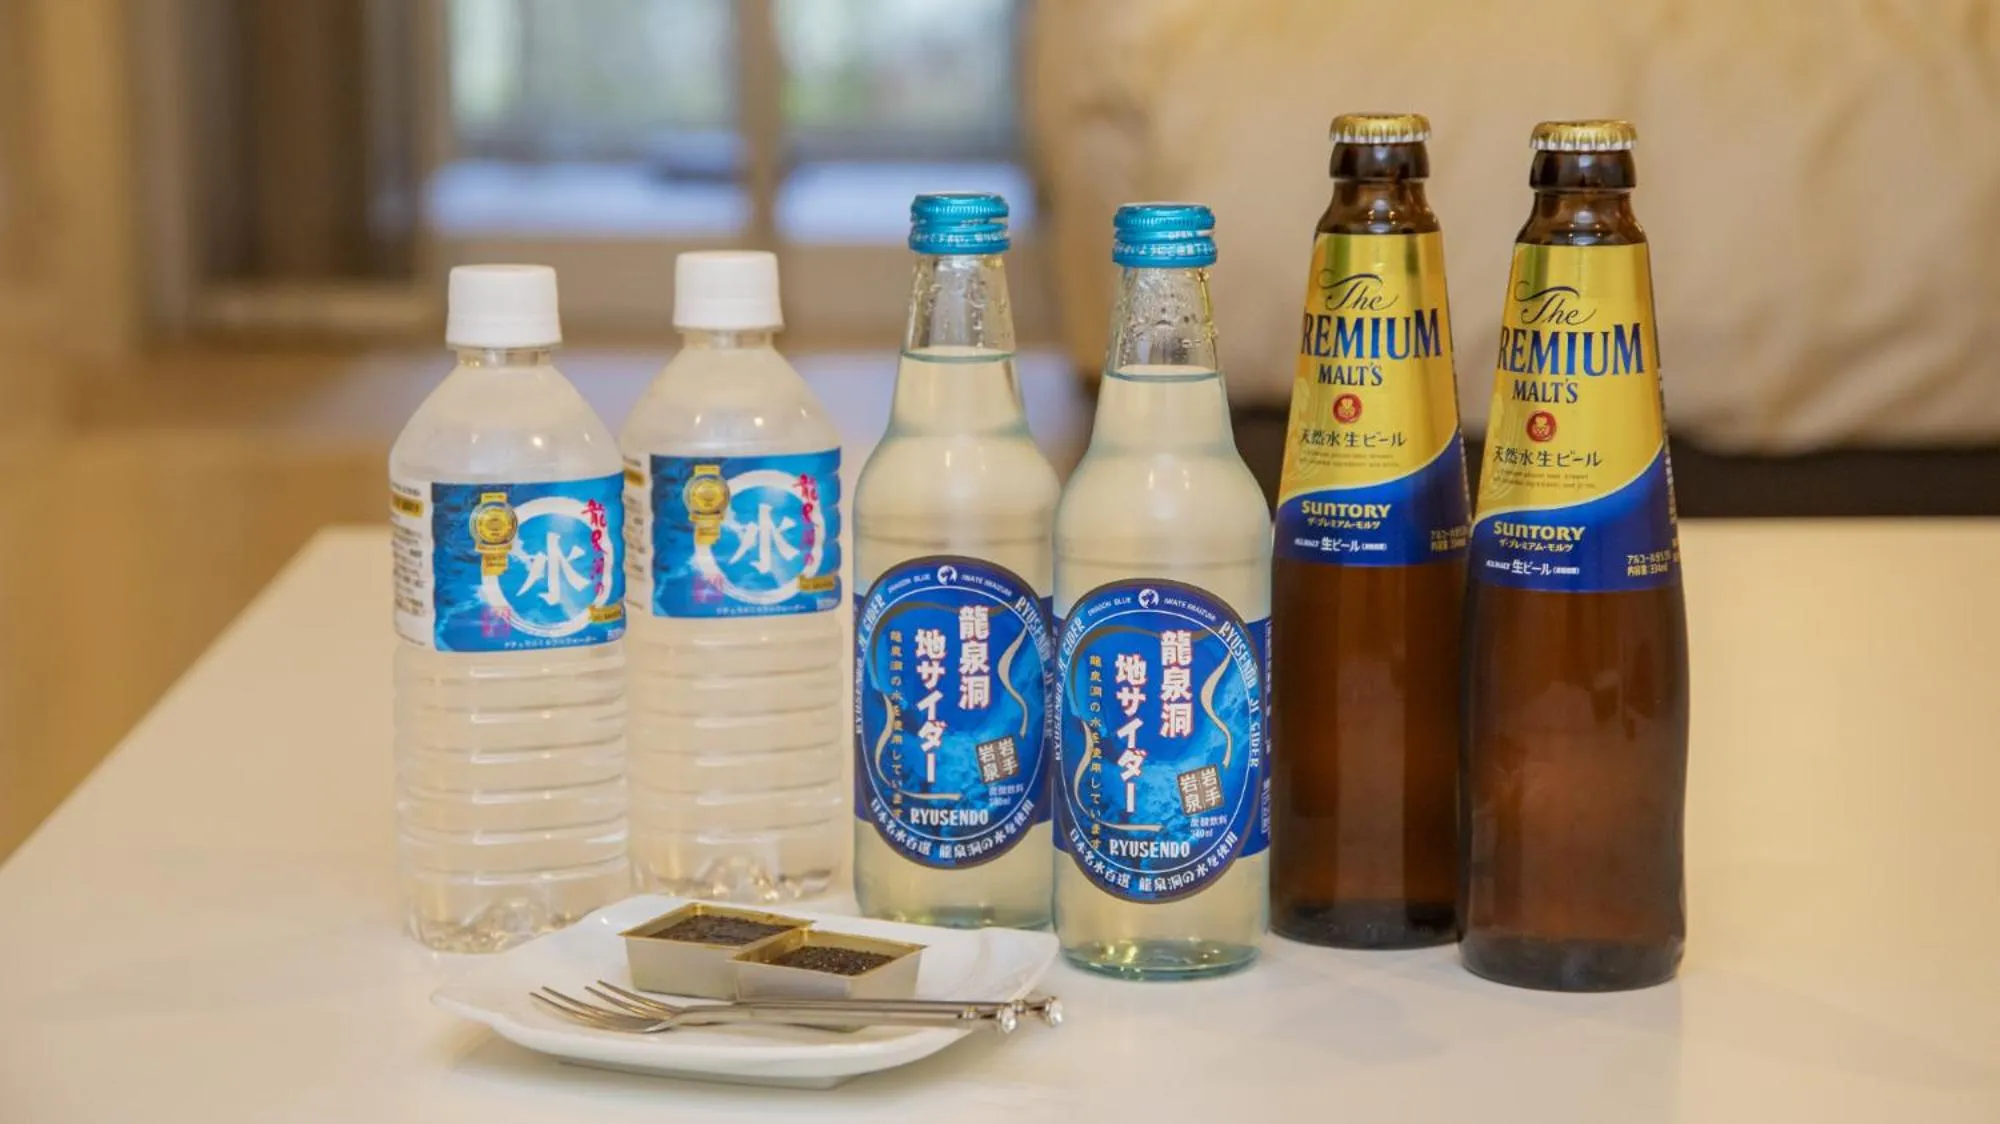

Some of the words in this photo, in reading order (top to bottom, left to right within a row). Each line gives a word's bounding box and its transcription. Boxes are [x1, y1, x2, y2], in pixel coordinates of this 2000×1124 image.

[1317, 268, 1399, 312] The
[1514, 280, 1598, 326] The
[1317, 362, 1383, 386] MALT'S
[1512, 378, 1579, 404] MALT'S
[1301, 500, 1392, 519] SUNTORY
[727, 503, 801, 574] 水
[1320, 536, 1360, 552] 生ビール
[1493, 521, 1586, 541] SUNTORY
[513, 532, 593, 605] 水
[1512, 558, 1552, 576] 生ビール
[1064, 617, 1086, 657] CIDER
[1218, 621, 1259, 689] RYUSENDO
[958, 605, 990, 710] 龍泉洞
[1160, 629, 1193, 738] 龍泉洞
[915, 628, 948, 783] 地サイダー
[1115, 653, 1148, 813] 地サイダー
[978, 744, 1000, 783] 岩泉
[999, 737, 1019, 776] 岩手
[1179, 774, 1202, 814] 岩泉
[1201, 767, 1221, 806] 岩手
[910, 807, 989, 826] RYUSENDO
[1069, 828, 1132, 889] 日本名水百選
[1109, 839, 1191, 859] RYUSENDO
